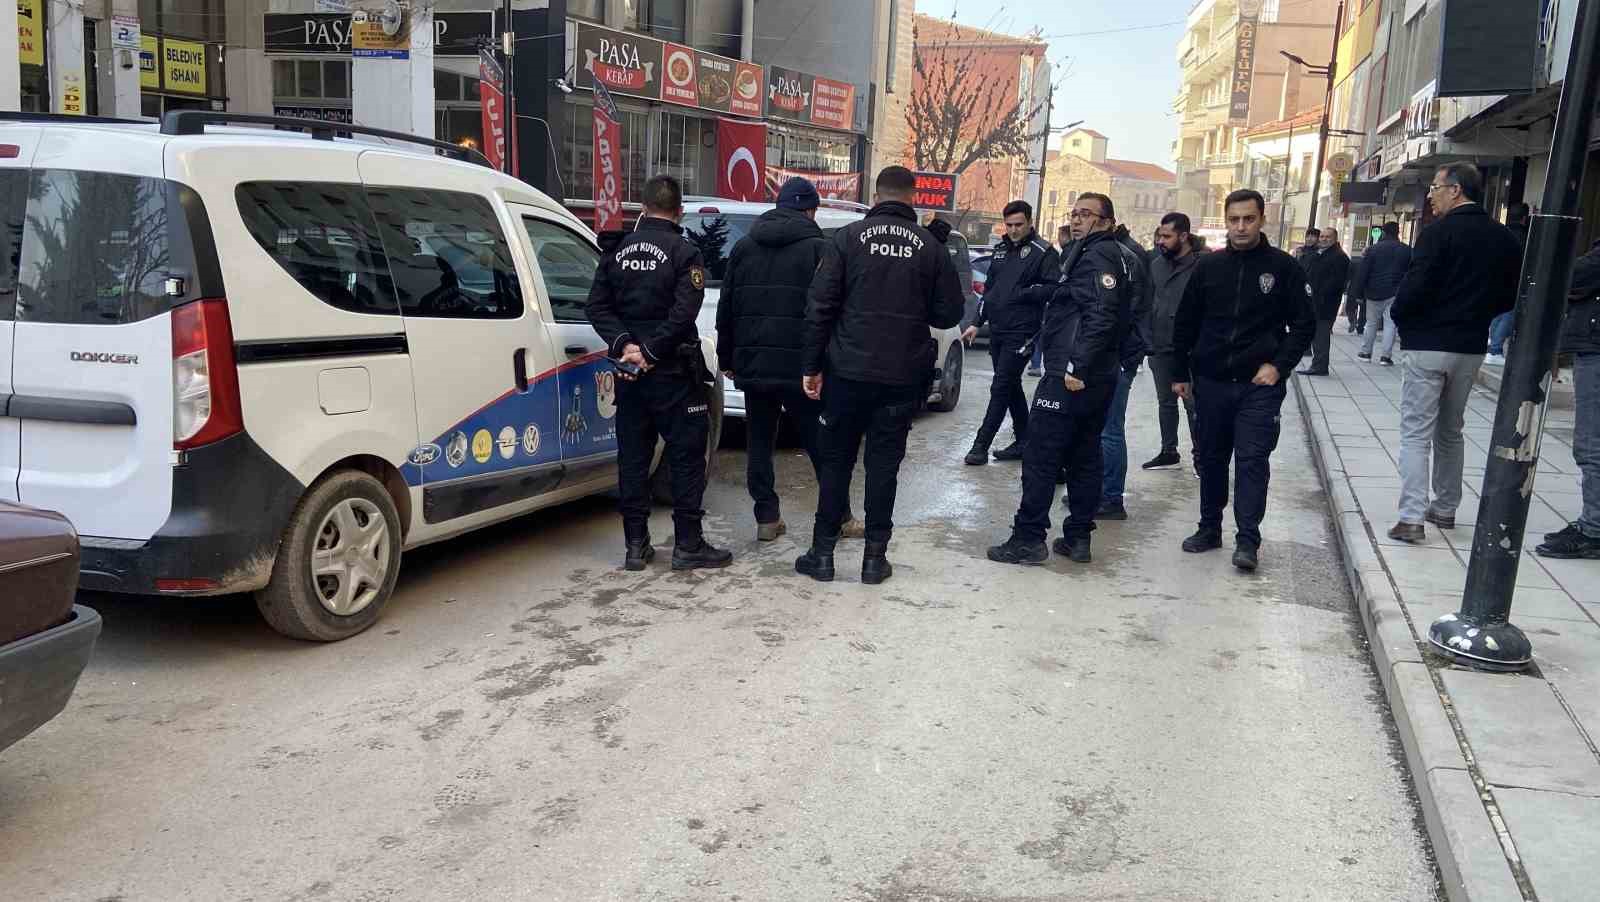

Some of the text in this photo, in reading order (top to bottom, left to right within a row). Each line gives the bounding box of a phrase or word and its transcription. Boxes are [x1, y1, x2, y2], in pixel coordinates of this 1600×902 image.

[303, 20, 353, 51] PAŞ
[599, 38, 641, 74] PAŞA
[606, 68, 634, 86] KEBAP
[889, 224, 924, 250] KUVVET
[639, 242, 668, 263] KUVVET
[70, 351, 138, 364] DOKKER
